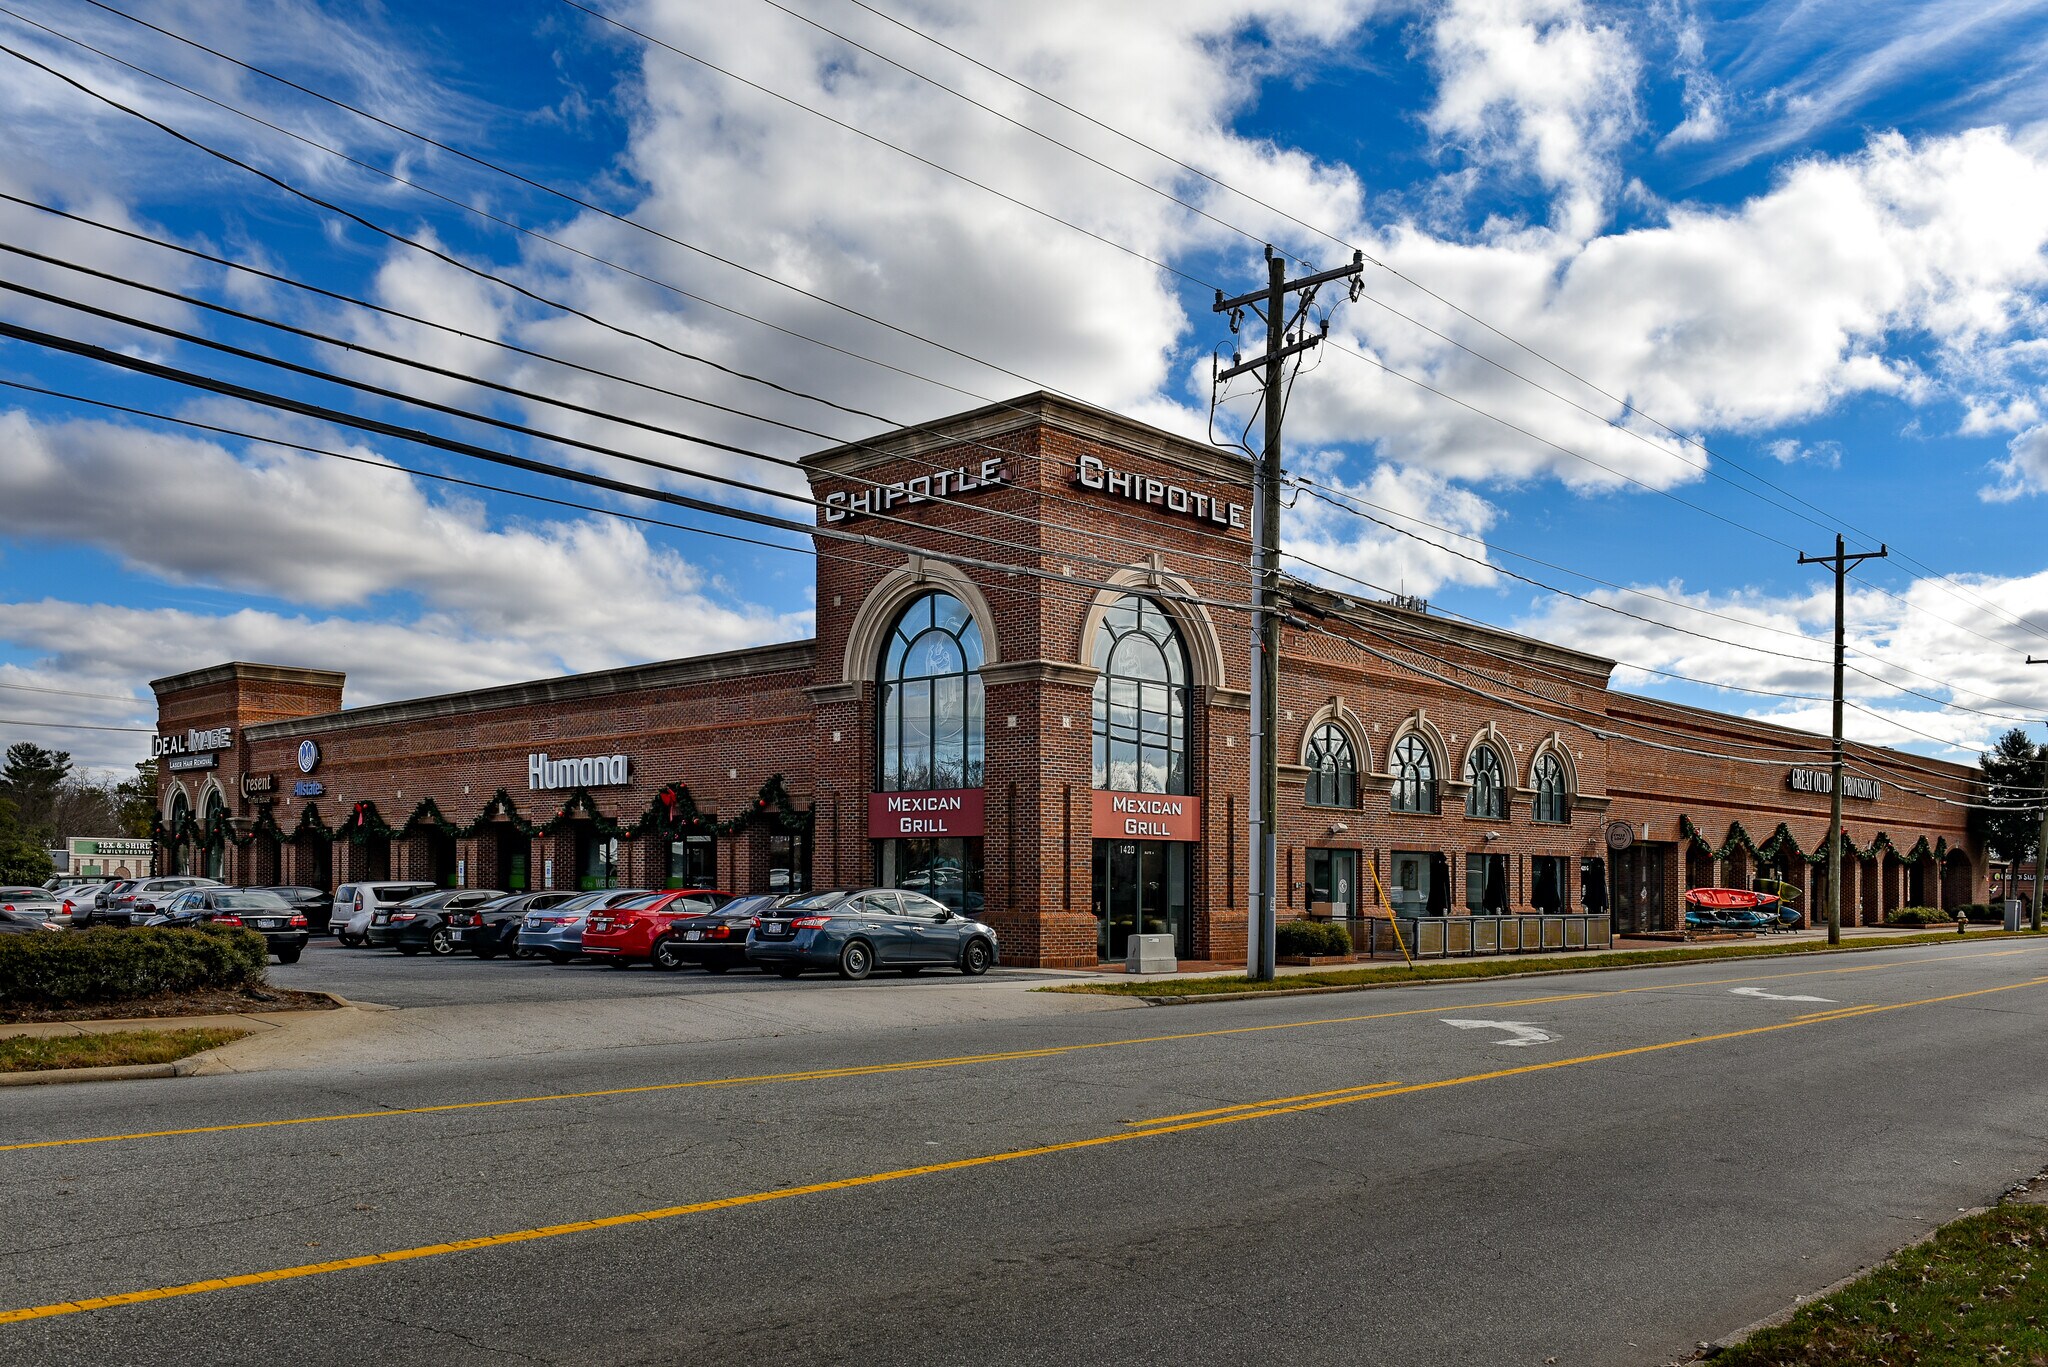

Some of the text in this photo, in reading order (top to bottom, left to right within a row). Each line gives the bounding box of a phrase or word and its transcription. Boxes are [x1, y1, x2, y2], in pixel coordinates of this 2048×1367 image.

[825, 457, 1002, 522] CHIPOTLE
[1078, 454, 1246, 529] CHIPOTLE
[152, 727, 231, 756] IDEAL IMAGE
[528, 753, 628, 790] Humana
[241, 772, 272, 799] Cresent
[294, 780, 322, 796] Allstate
[1792, 768, 1813, 791] GREAT
[1813, 771, 1842, 794] OUTD
[1843, 776, 1872, 799] PROVISION
[888, 797, 961, 812] MEXICAN
[1112, 796, 1182, 815] MEXICAN
[900, 817, 948, 833] GRILL
[1125, 818, 1171, 836] GRILL
[98, 841, 115, 849] TEX
[116, 841, 124, 849] &
[1120, 845, 1135, 854] 1420
